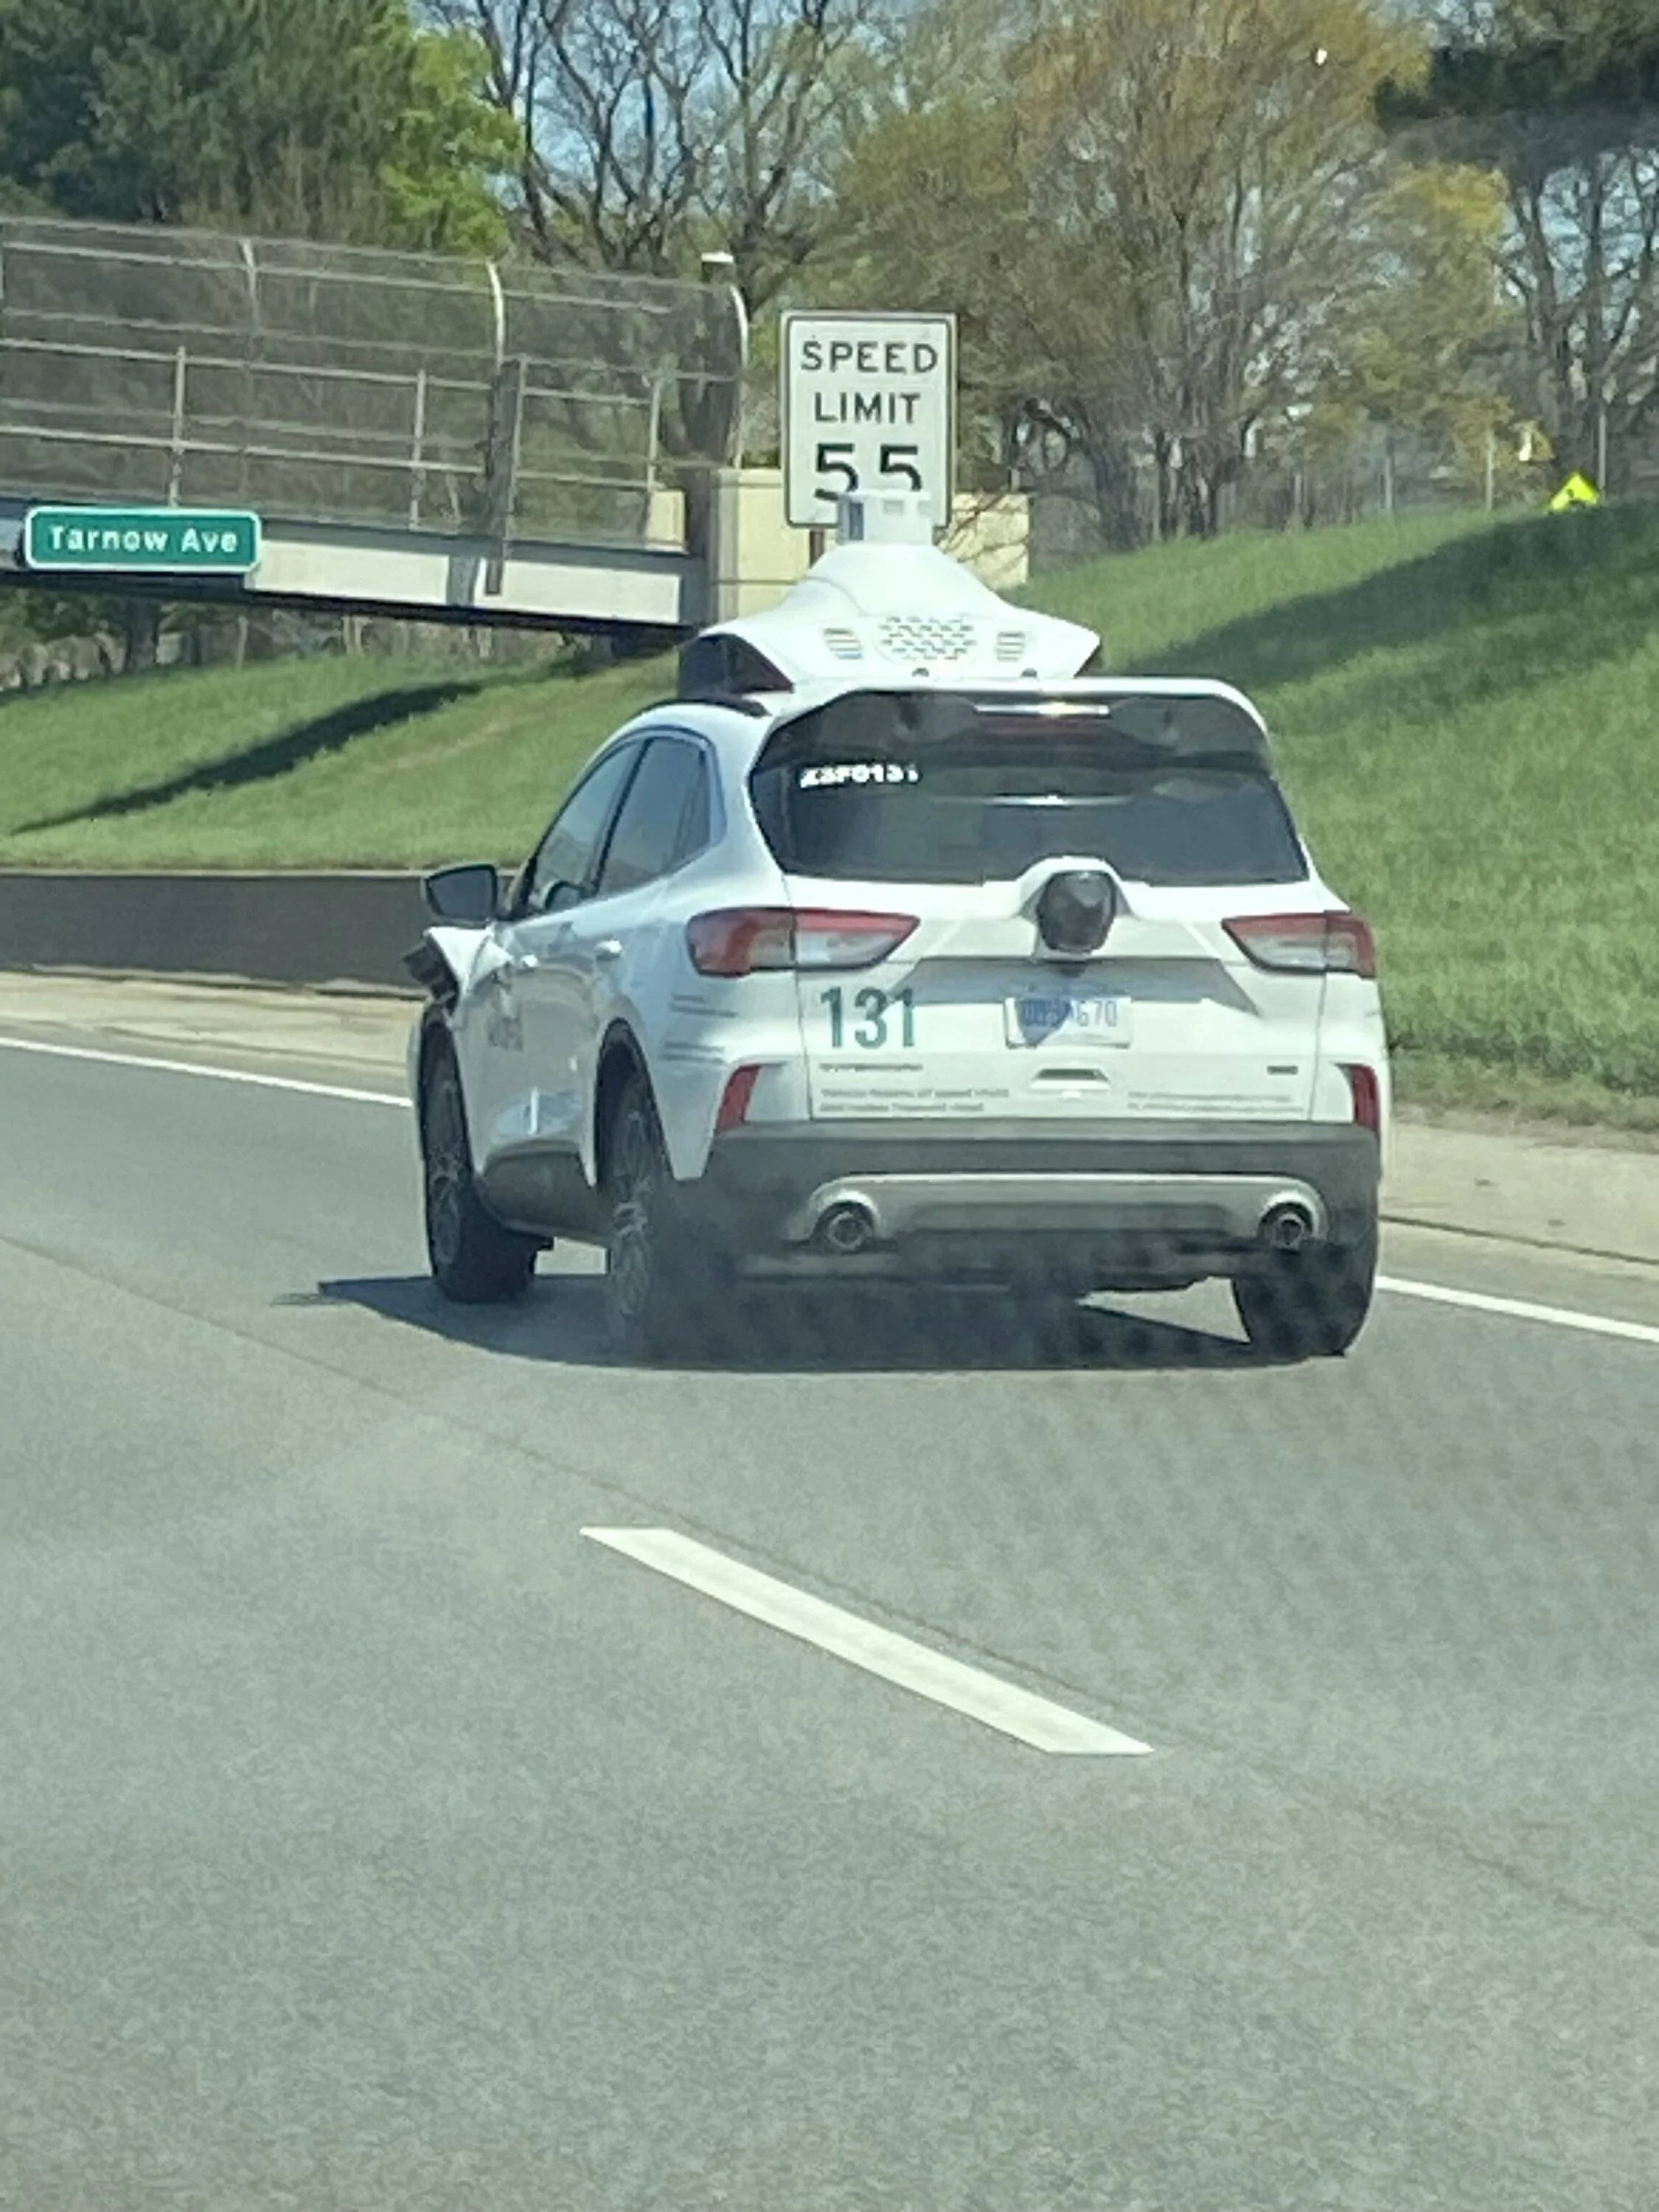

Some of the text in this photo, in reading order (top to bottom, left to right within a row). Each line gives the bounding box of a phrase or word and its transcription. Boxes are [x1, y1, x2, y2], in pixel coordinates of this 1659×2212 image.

[801, 341, 938, 374] SPEED
[815, 392, 921, 424] LIMIT
[813, 443, 922, 501] 55
[49, 524, 238, 553] Tarnow Ave
[821, 987, 914, 1049] 131
